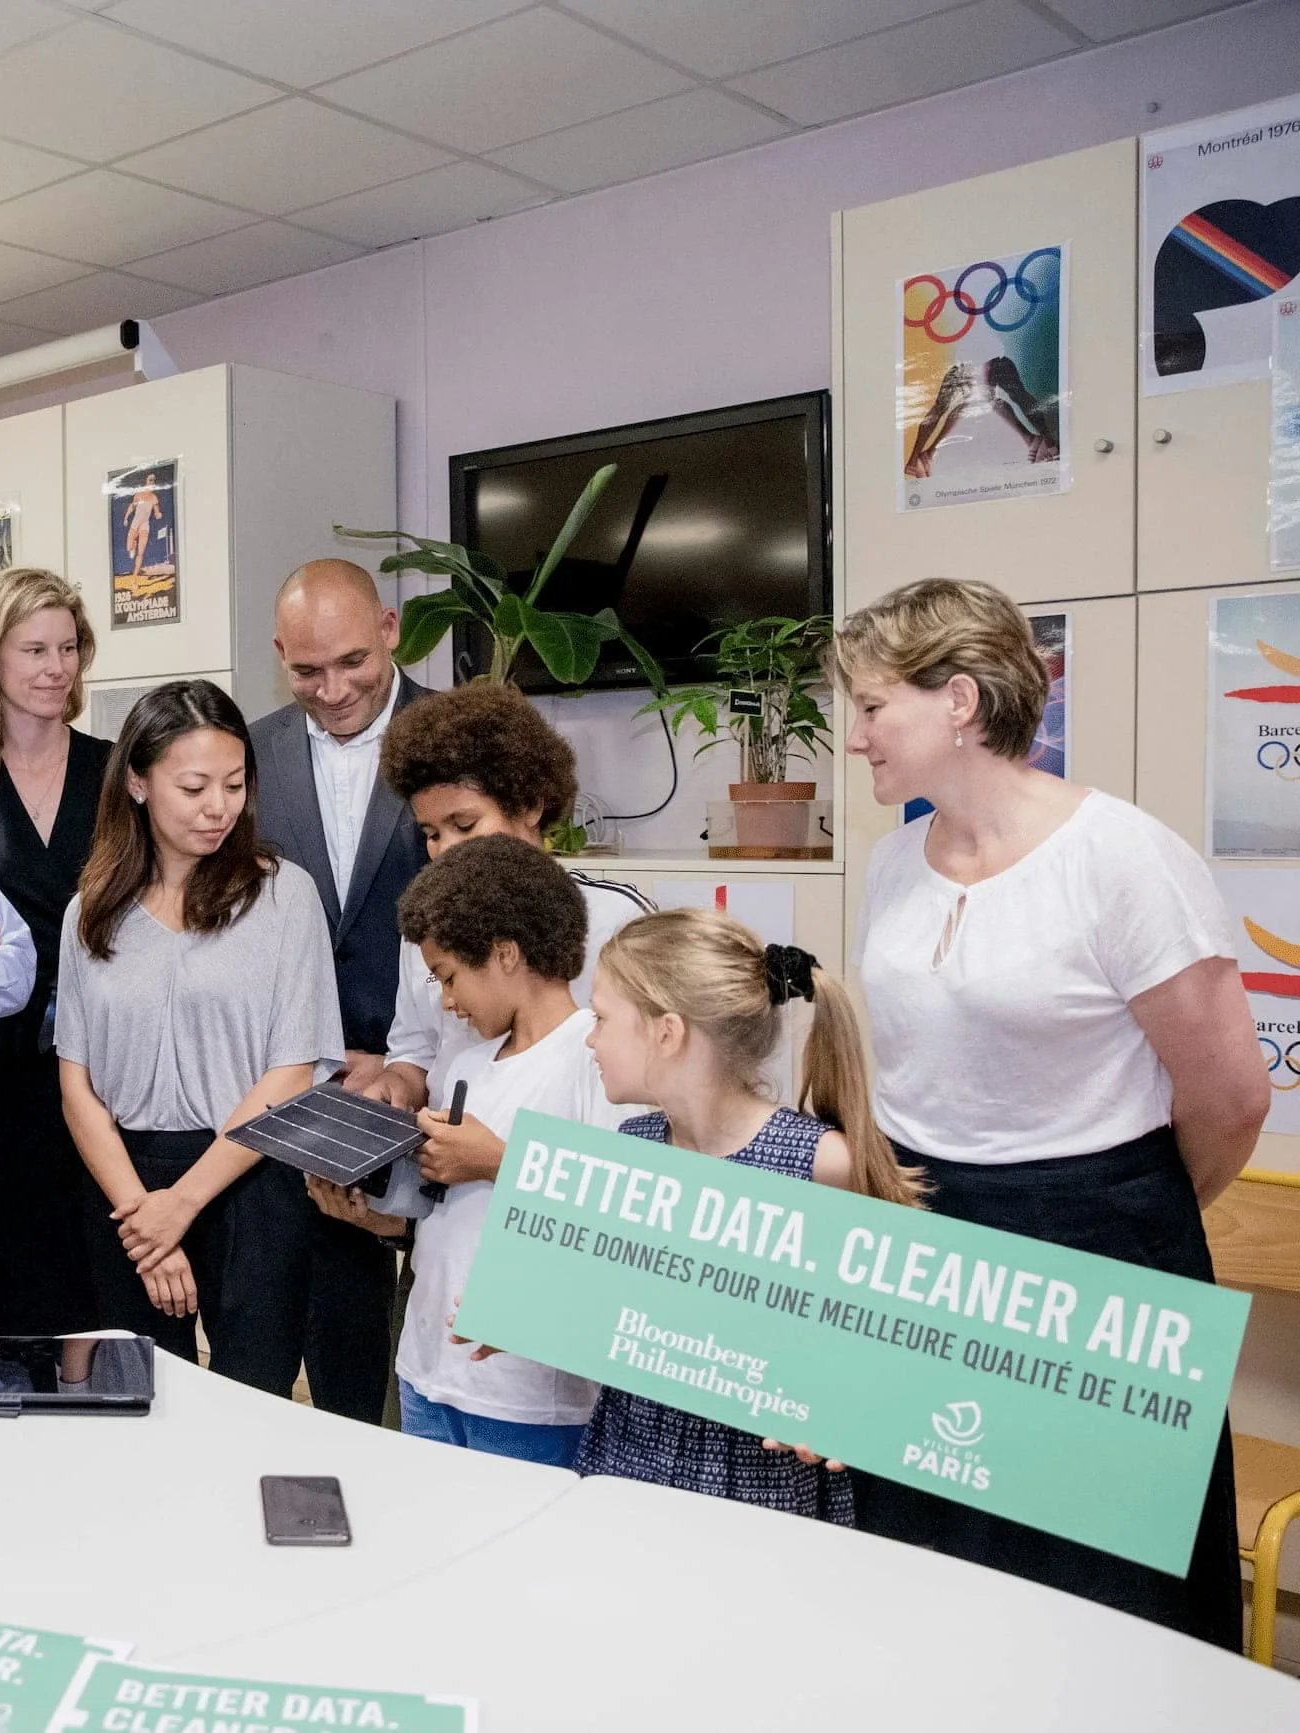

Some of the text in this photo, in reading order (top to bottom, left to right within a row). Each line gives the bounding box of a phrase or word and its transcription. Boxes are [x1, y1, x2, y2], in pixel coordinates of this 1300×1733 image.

[1198, 120, 1300, 156] Montréal 1976
[127, 606, 177, 623] AMSTERDAM
[516, 1140, 1203, 1382] BETTER DATA. CLEANER AIR.
[504, 1206, 1193, 1431] PLUS DE DONNÉES POUR UNE MEILLEURE QUALITÉ DE L'AIR
[614, 1306, 769, 1384] Bloomberg
[607, 1333, 810, 1423] Philanthropies
[903, 1443, 991, 1491] PARIS
[115, 1678, 400, 1731] BETTER DATA.
